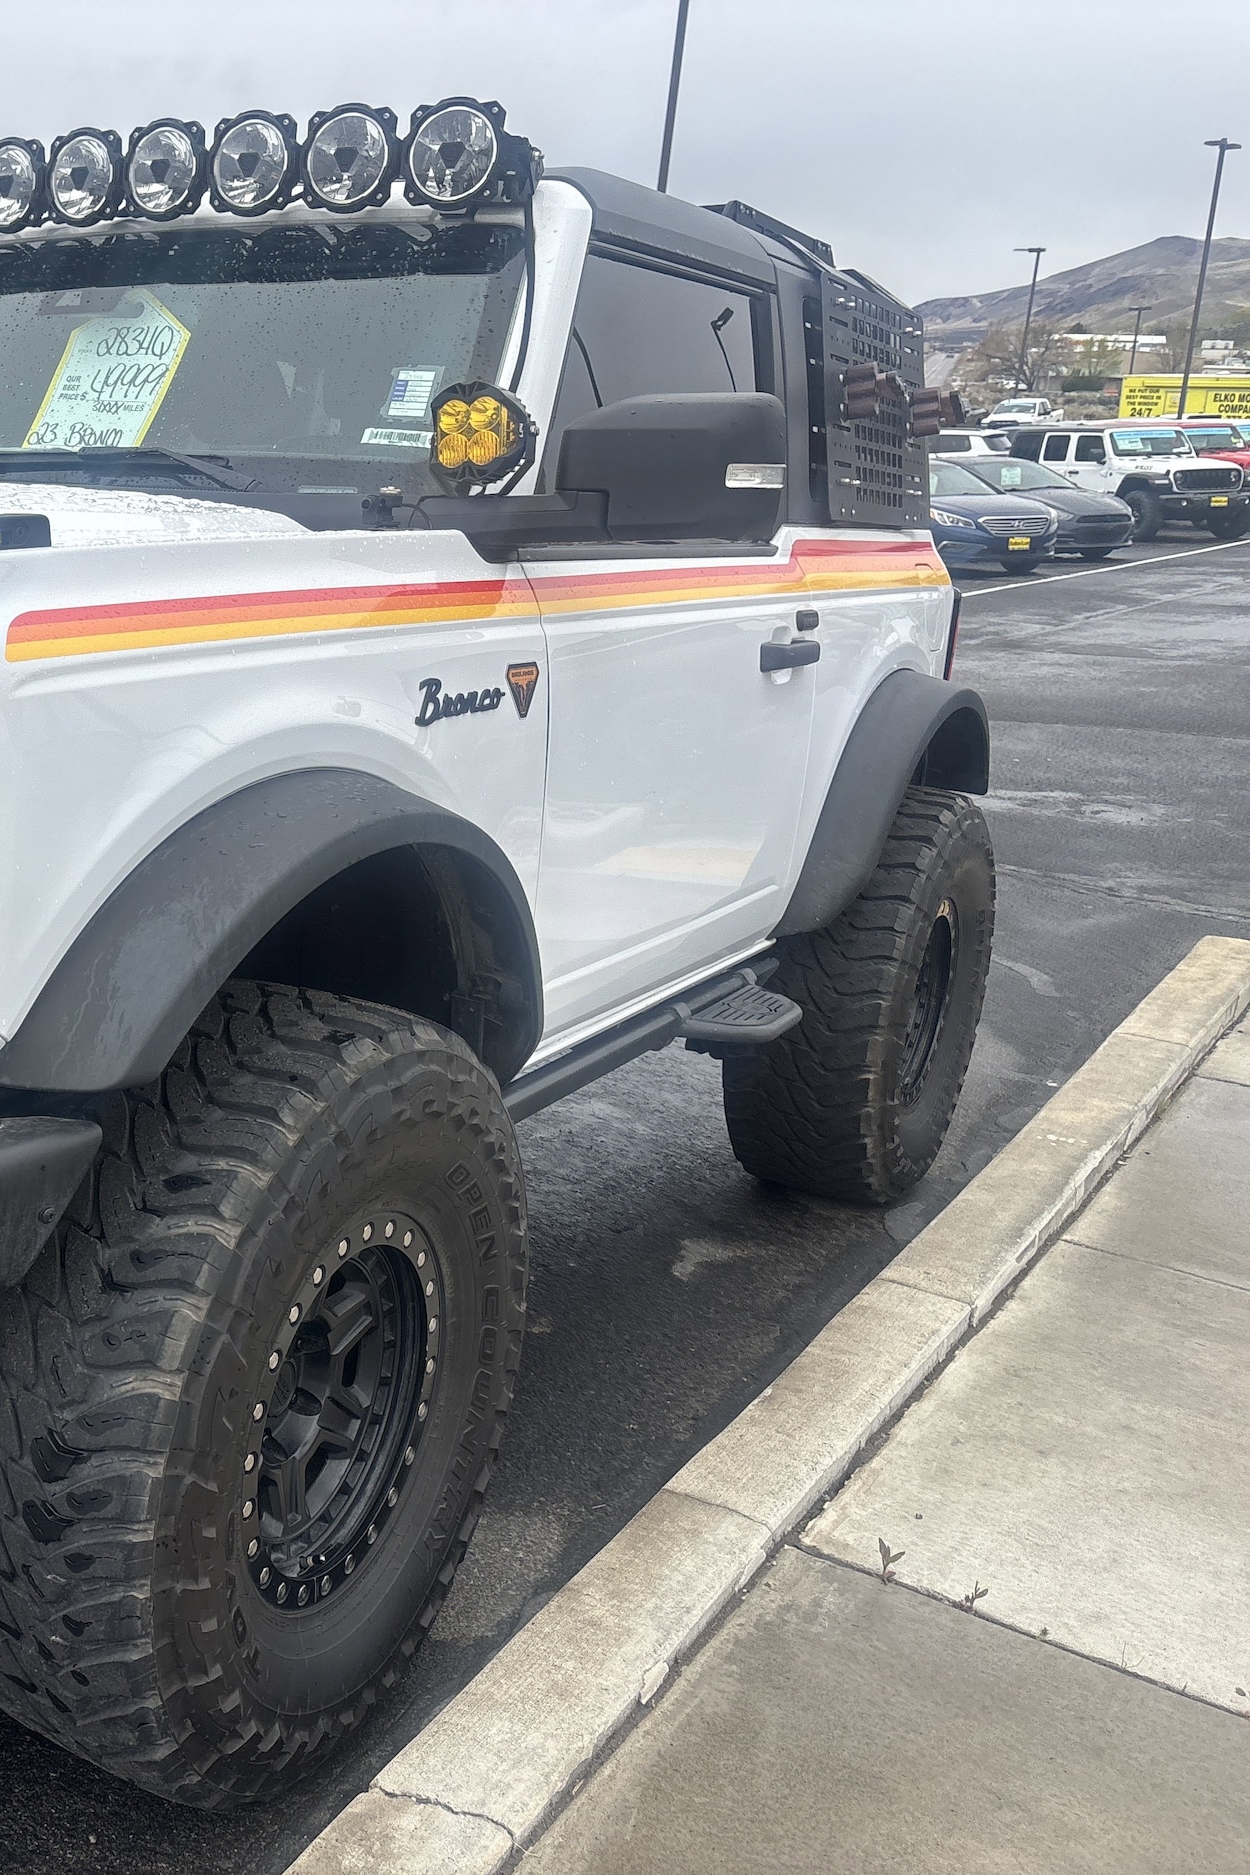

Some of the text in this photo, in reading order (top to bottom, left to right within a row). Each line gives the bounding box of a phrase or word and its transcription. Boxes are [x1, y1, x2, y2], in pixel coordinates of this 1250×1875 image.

[66, 375, 82, 383] OUR
[1213, 393, 1236, 403] ELKO
[122, 404, 145, 412] MILES
[1130, 408, 1153, 418] 24/7
[1218, 404, 1250, 413] COMPA
[28, 422, 59, 445] 23
[415, 678, 506, 727] Bronco
[420, 1160, 503, 1574] OPEN COUNTRY
